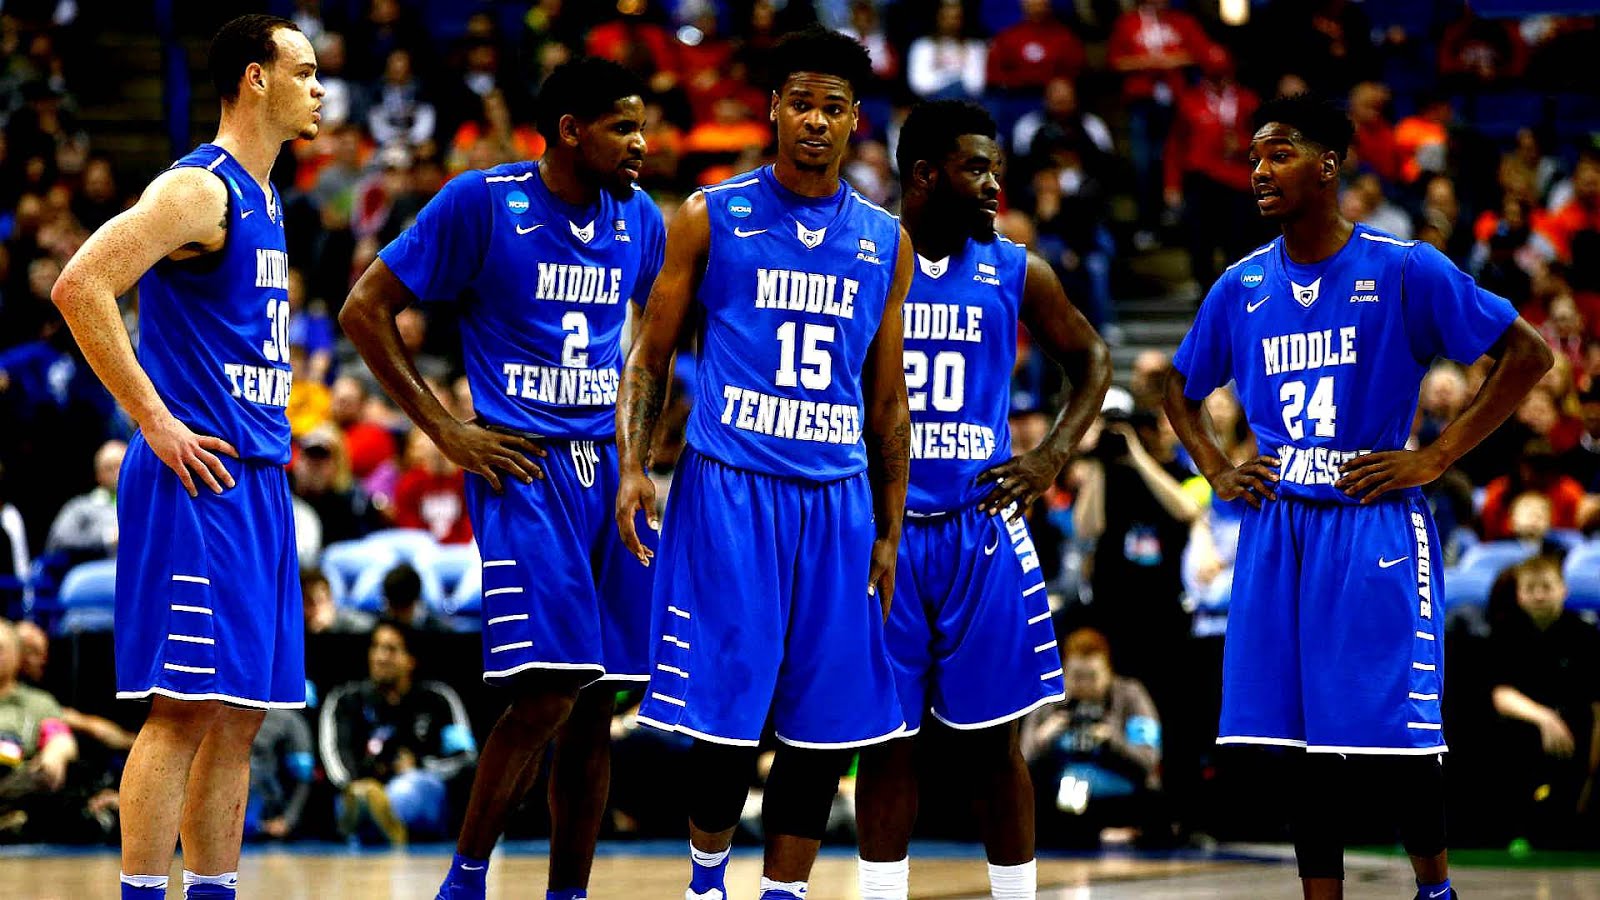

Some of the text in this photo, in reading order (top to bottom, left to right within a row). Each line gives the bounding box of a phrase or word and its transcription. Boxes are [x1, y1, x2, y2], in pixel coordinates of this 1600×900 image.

[535, 262, 622, 305] MIDDLE
[755, 268, 859, 320] MIDDLE
[262, 298, 291, 364] 30
[561, 310, 590, 369] 2
[902, 302, 983, 343] IDDLE
[1261, 325, 1358, 377] MIDDLE
[775, 321, 836, 391] 15
[902, 350, 966, 413] 20
[1279, 376, 1337, 442] 24
[909, 421, 996, 461] NESSEE
[1411, 511, 1432, 620] RAIDERS
